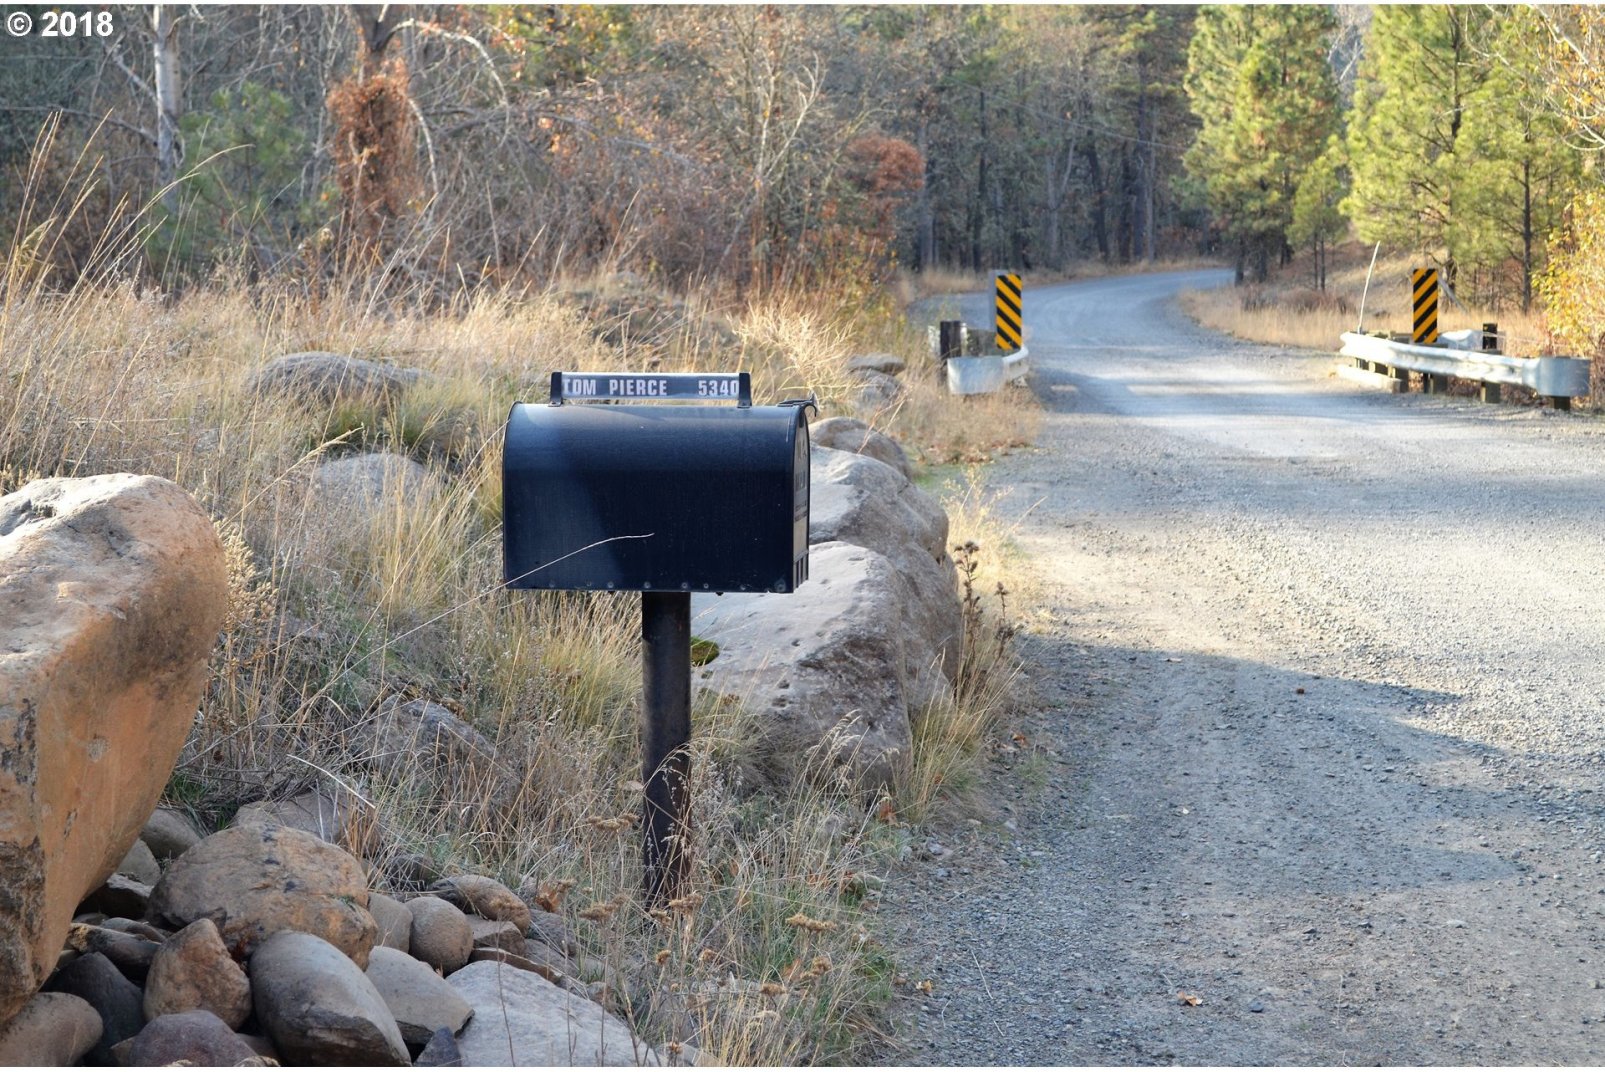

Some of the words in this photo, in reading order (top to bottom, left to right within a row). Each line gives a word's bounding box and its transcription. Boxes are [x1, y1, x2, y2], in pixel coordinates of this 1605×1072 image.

[562, 379, 597, 396] TOM
[609, 379, 668, 396] PIERCE
[698, 379, 740, 396] 5340
